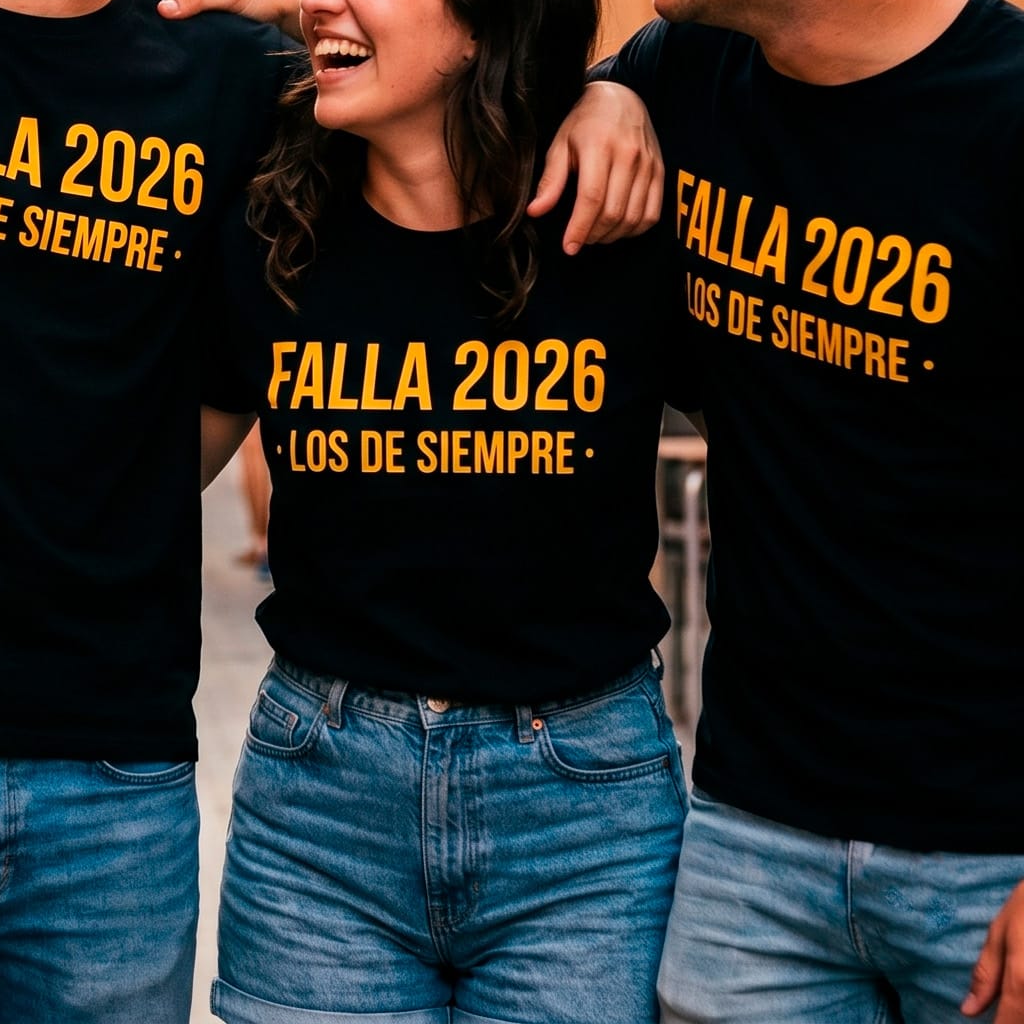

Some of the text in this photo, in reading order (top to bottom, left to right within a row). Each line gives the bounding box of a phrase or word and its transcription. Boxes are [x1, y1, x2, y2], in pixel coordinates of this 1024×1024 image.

[60, 123, 205, 216] 2026
[18, 205, 169, 272] SIEMPRE
[677, 169, 953, 324] FALLA 2026
[686, 272, 910, 383] LOS DE SIEMPRE
[267, 338, 607, 413] FALLA 2026
[289, 429, 576, 475] LOS DE SIEMPRE
